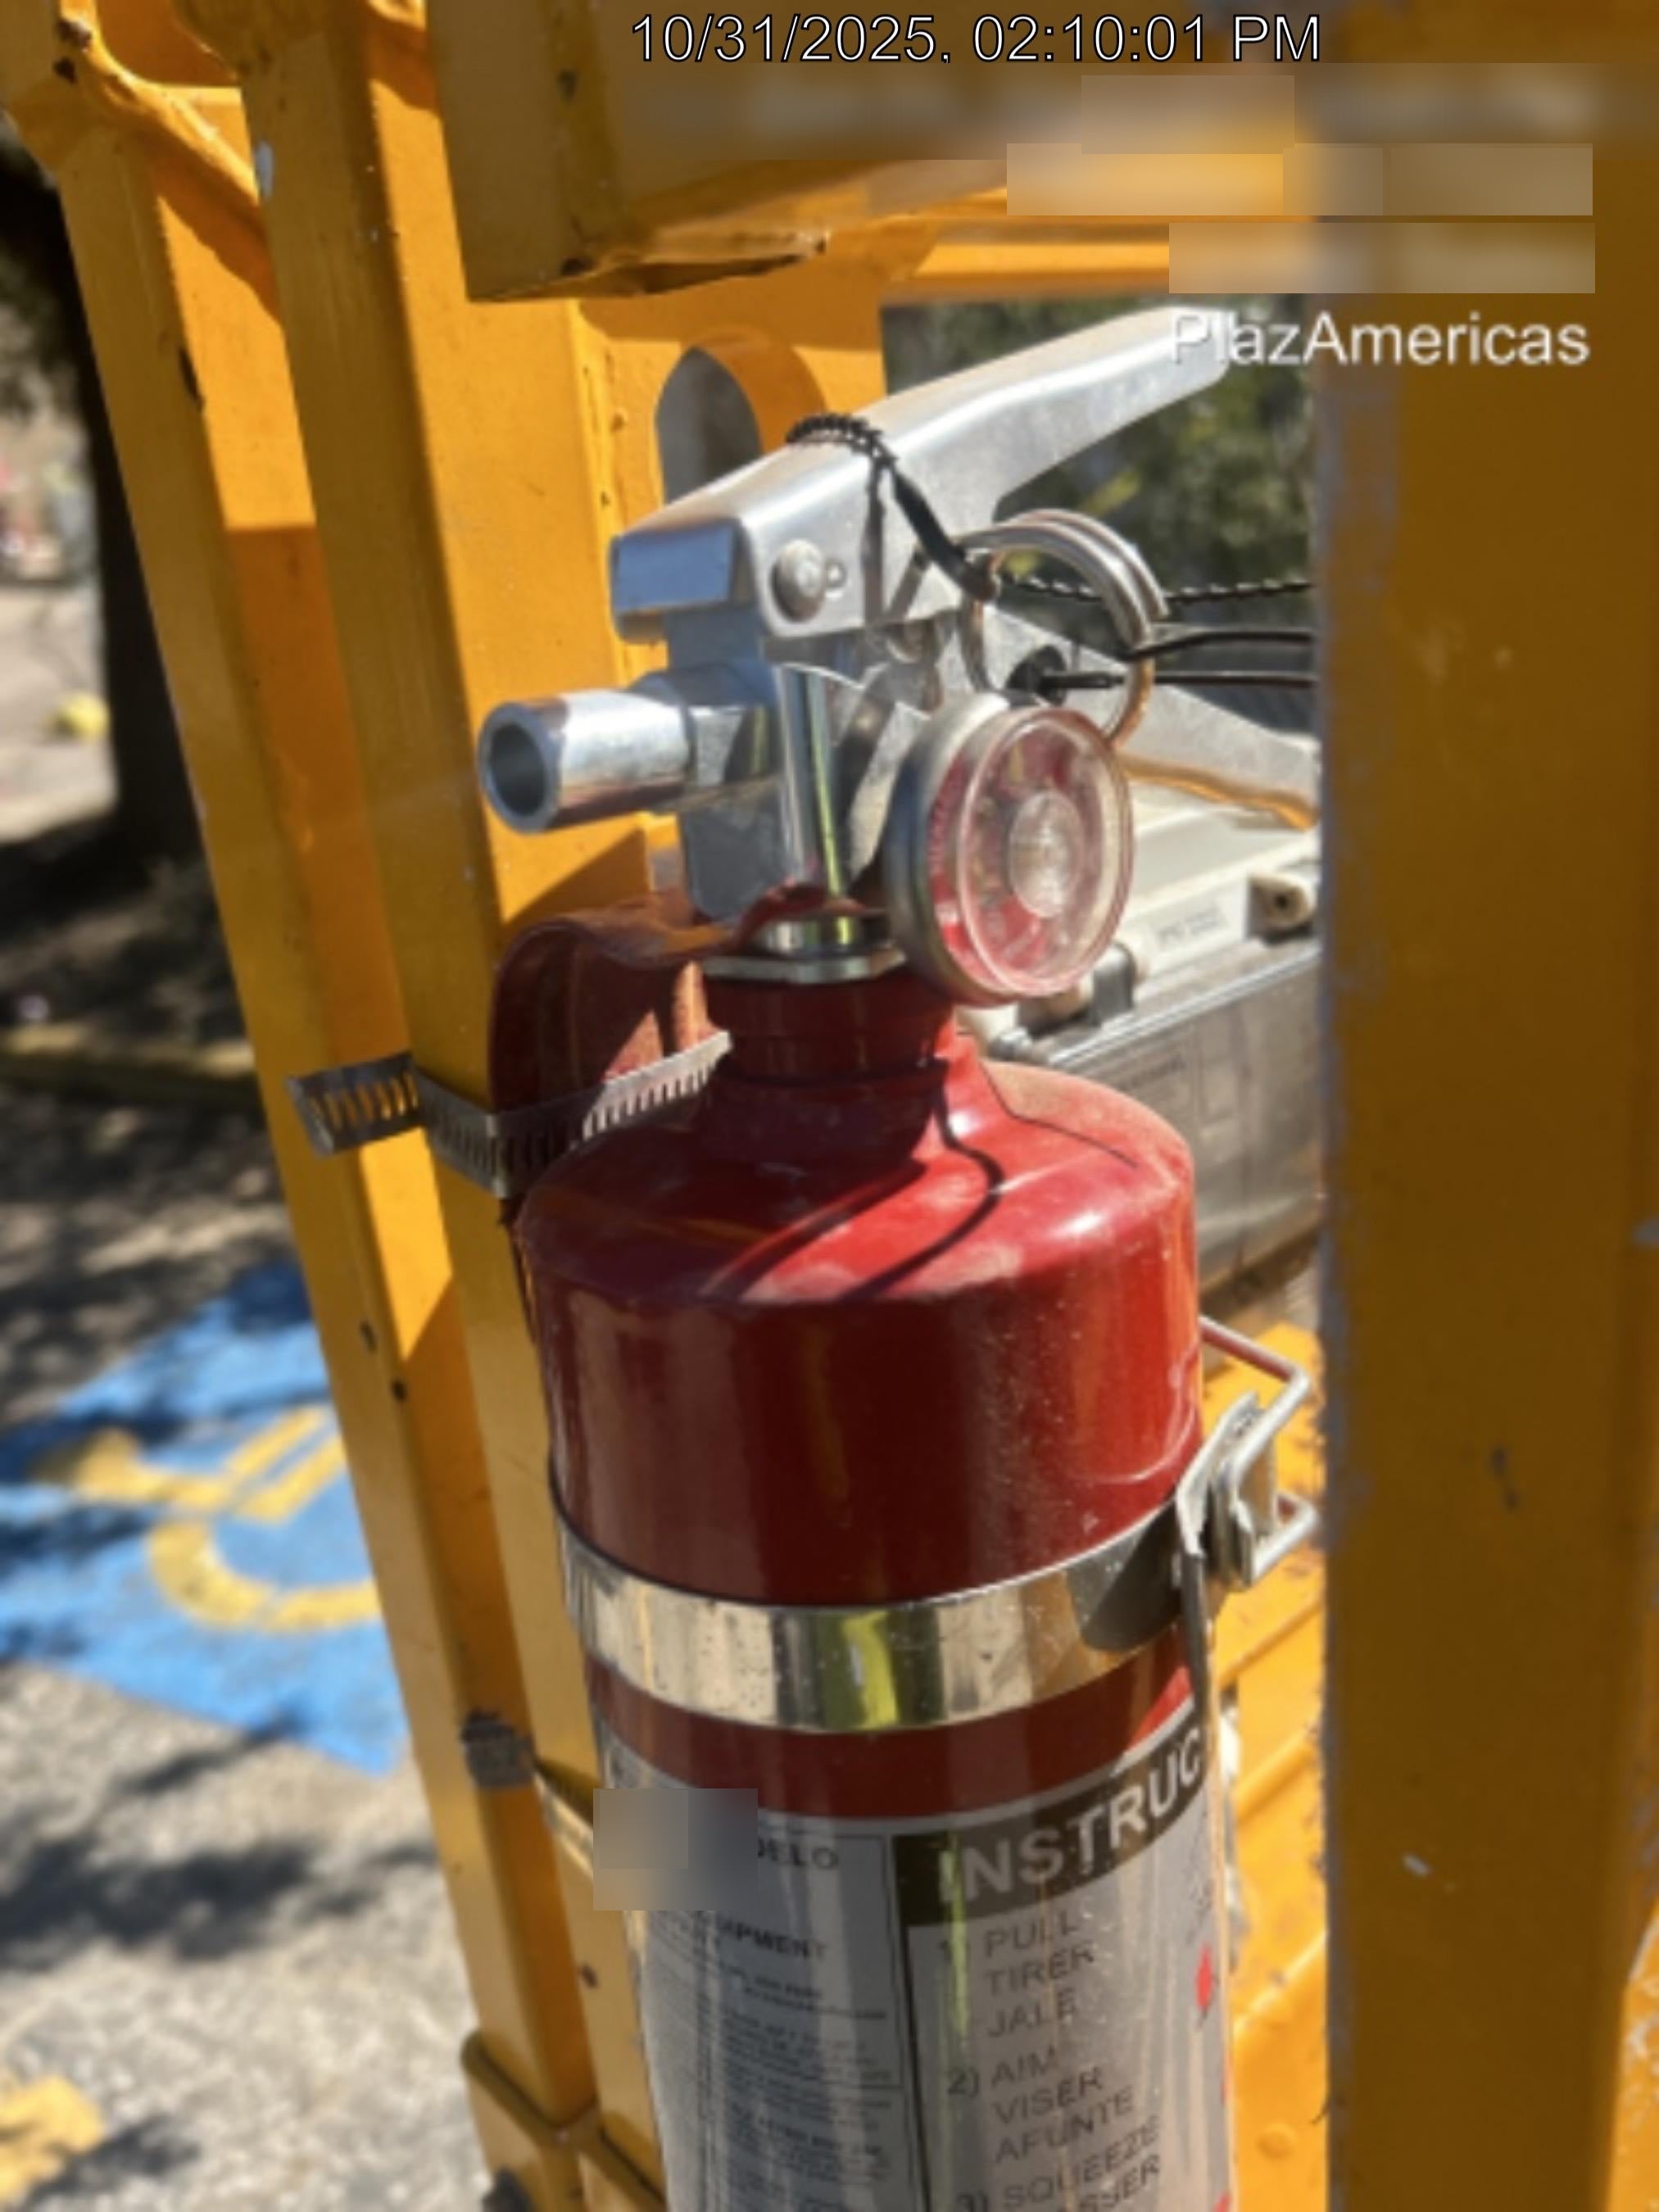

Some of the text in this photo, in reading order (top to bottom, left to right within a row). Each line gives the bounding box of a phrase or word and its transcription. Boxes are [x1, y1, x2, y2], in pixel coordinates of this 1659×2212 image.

[939, 1727, 1200, 1905] INSTRUC
[985, 1911, 1082, 1958] PULL
[986, 1943, 1095, 1997] TIRER
[987, 1988, 1084, 2039] JALE
[947, 2044, 1059, 2097] 2) AIM
[992, 2065, 1103, 2125] VISER
